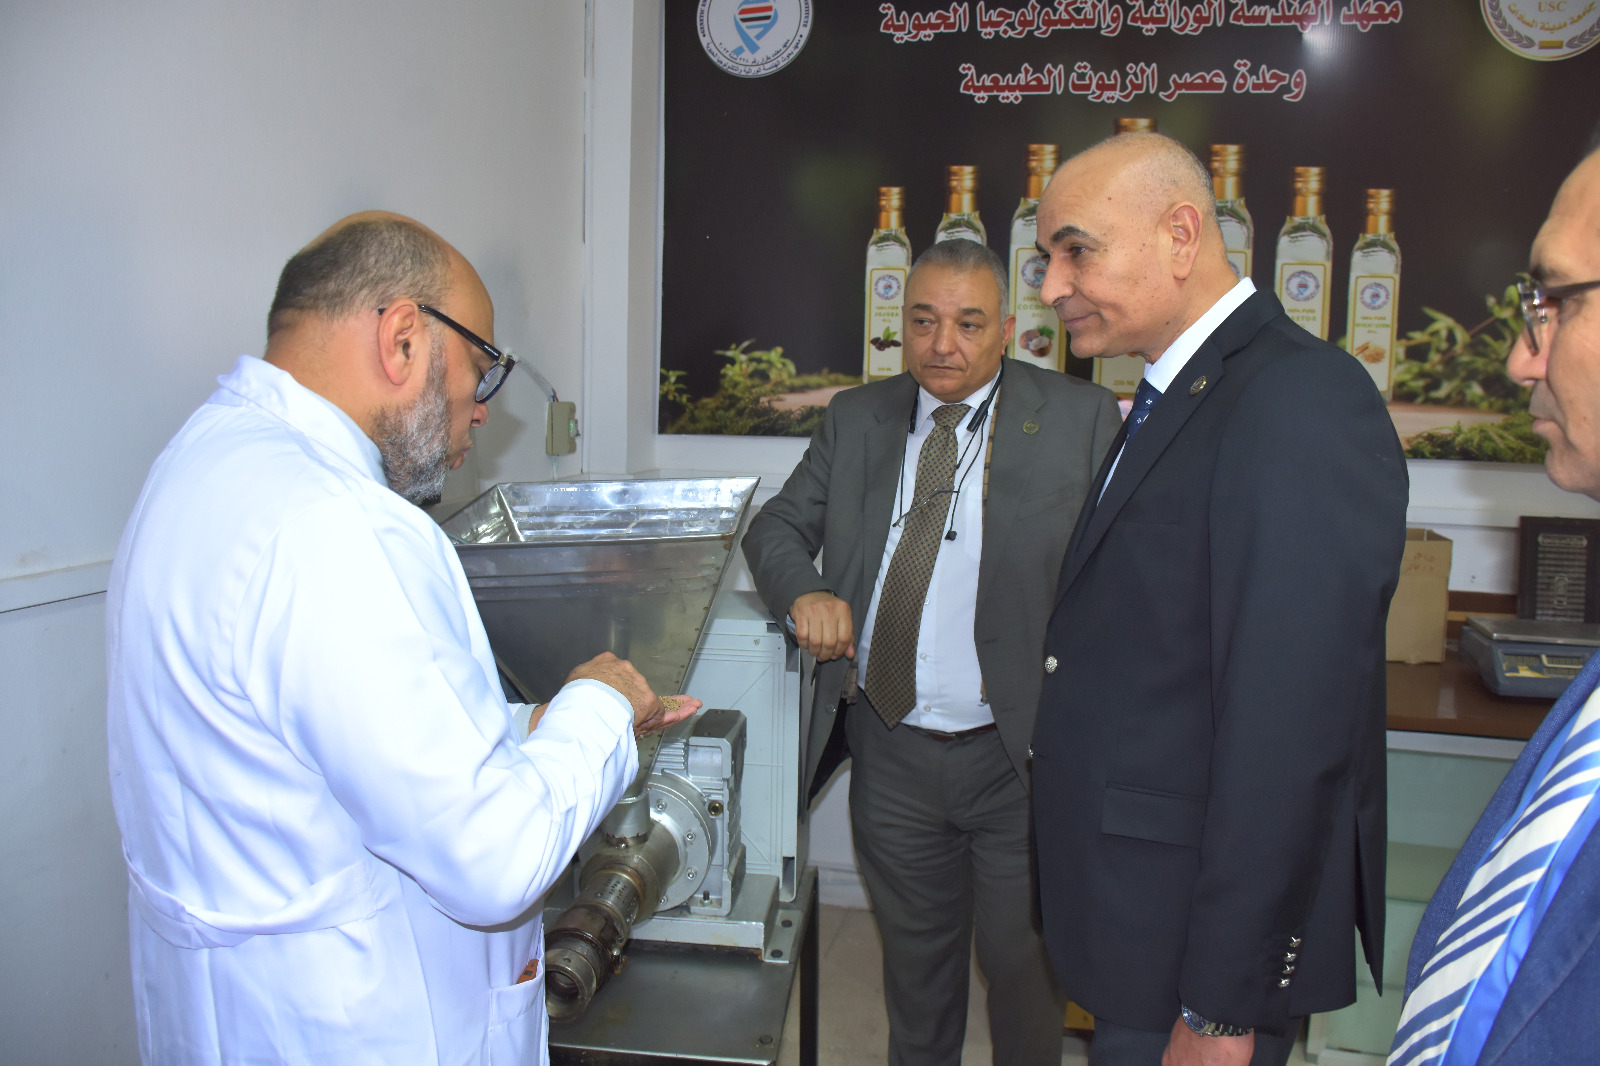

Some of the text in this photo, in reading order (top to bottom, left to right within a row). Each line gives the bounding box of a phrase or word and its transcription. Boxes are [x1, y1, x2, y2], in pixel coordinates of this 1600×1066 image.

[879, 2, 969, 43] الحيوية
[976, 0, 1123, 38] والتكنولوجيا
[1229, 0, 1333, 33] الهندسة
[1340, 1, 1403, 32] معهد
[1538, 1, 1568, 12] USC
[959, 59, 1306, 104] وحدة عصر الزيوت الطبيعية
